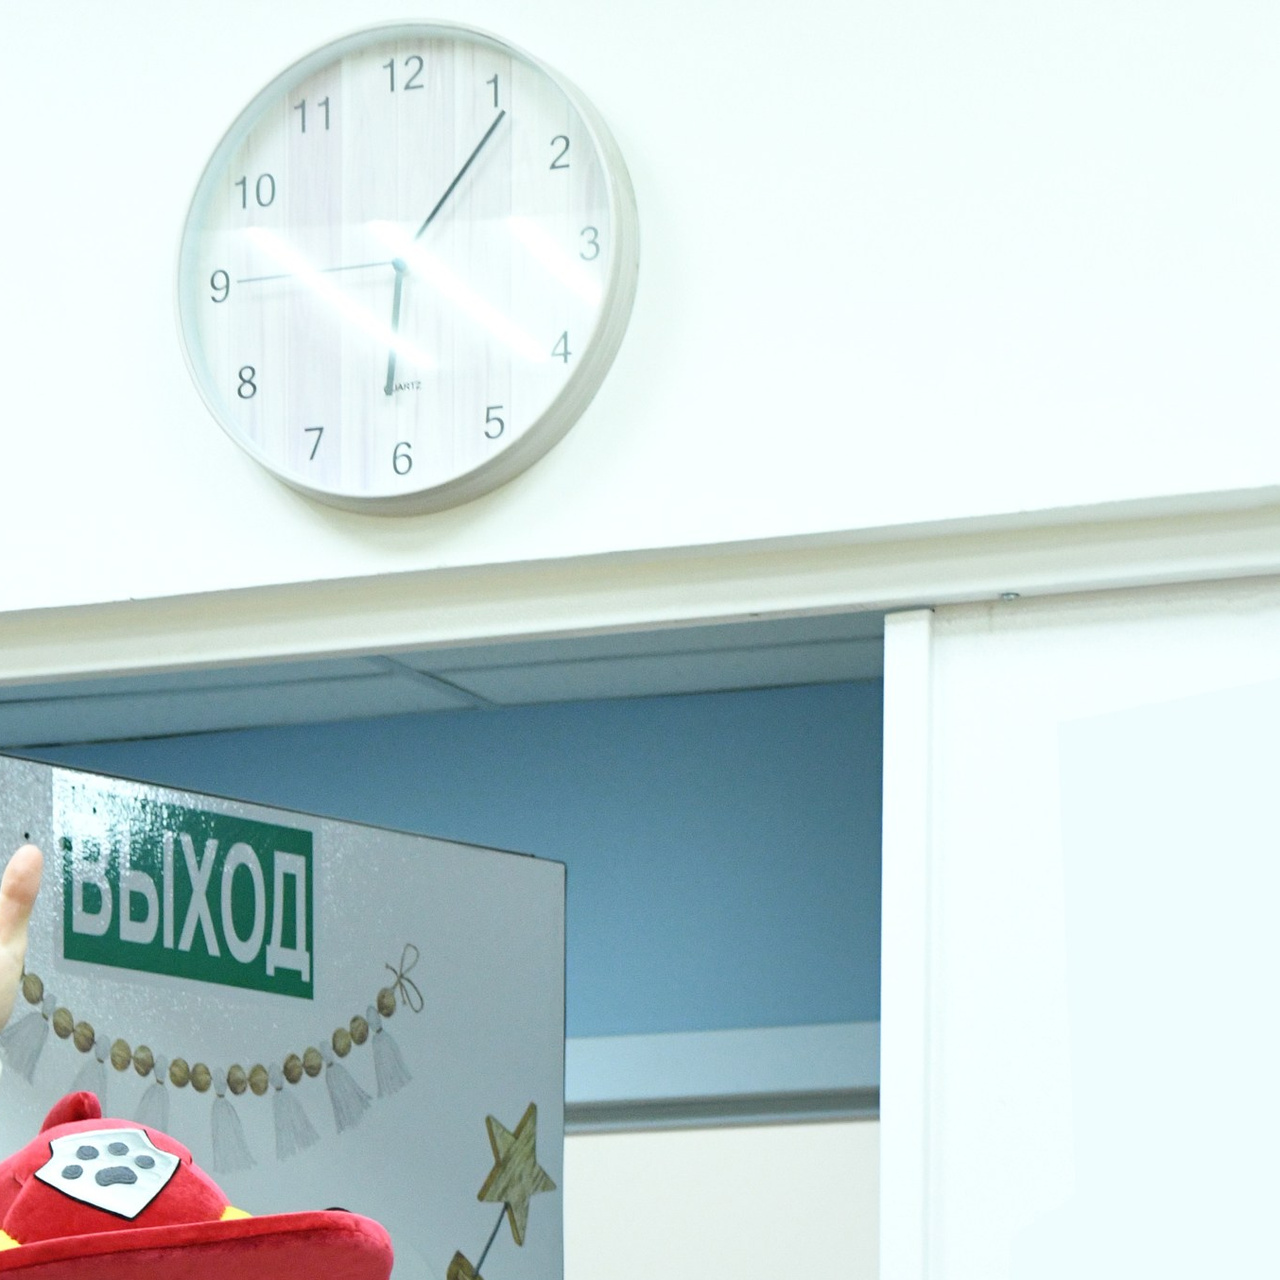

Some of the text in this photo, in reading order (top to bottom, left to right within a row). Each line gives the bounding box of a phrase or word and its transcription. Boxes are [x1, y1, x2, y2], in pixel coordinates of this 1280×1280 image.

[382, 55, 424, 92] 12
[486, 73, 499, 108] 1
[293, 95, 330, 133] 11
[549, 135, 570, 170] 2
[234, 173, 276, 209] 10
[579, 226, 601, 261] 3
[210, 269, 231, 303] 9
[551, 330, 573, 364] 4
[237, 365, 258, 400] 8
[484, 405, 506, 440] 5
[304, 426, 324, 461] 7
[392, 441, 414, 476] 6
[72, 814, 310, 982] ВЫХОД
